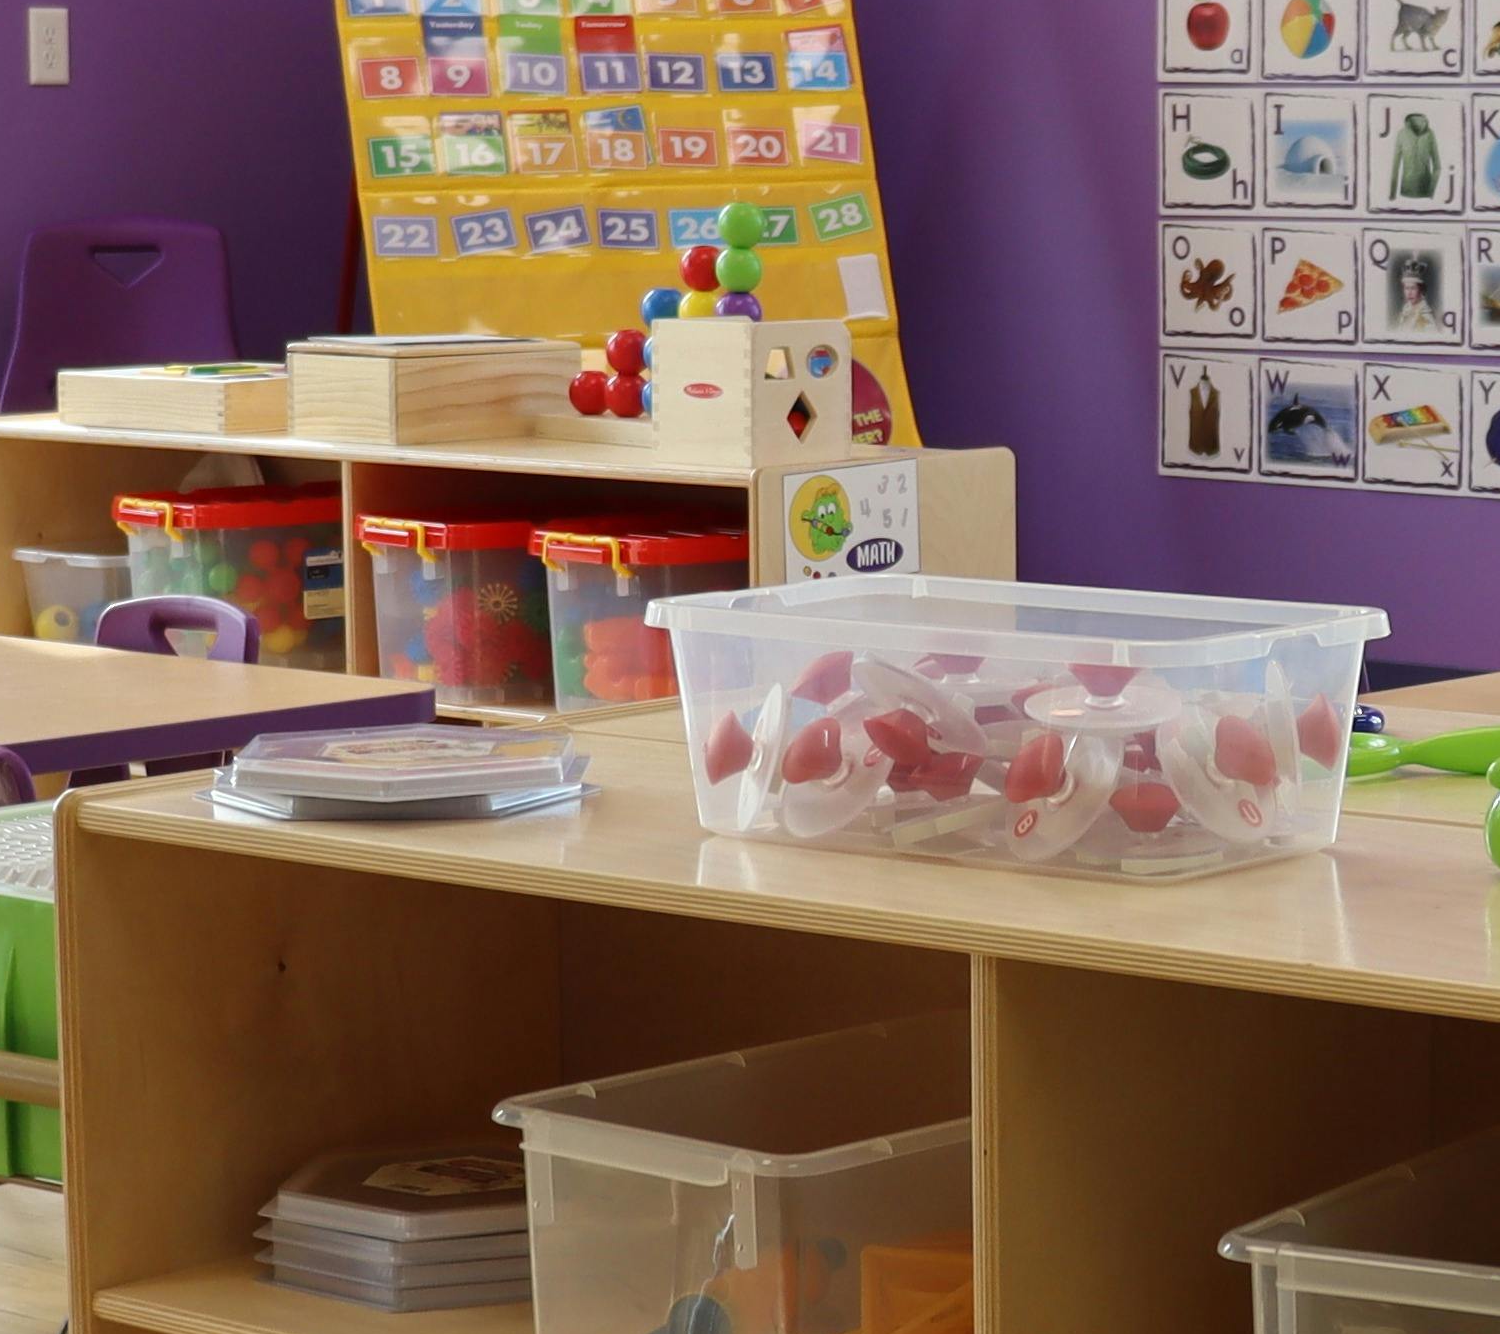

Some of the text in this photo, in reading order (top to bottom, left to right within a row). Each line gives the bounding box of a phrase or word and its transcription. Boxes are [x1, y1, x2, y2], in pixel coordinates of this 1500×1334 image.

[380, 60, 837, 90] 8 9 10 11 12 13 14
[1231, 48, 1243, 65] a
[1340, 46, 1353, 72] b
[1443, 49, 1457, 67] c
[1172, 104, 1190, 131] H
[1272, 105, 1283, 134] I
[1379, 107, 1390, 138] J
[1480, 109, 1500, 141] K
[381, 129, 847, 168] 15 16 17 18 19 20 21
[1232, 169, 1248, 200] h
[1444, 165, 1454, 204] j
[381, 225, 430, 249] 22
[461, 218, 508, 244] 23
[534, 217, 583, 244] 24
[605, 217, 651, 241] 25
[677, 216, 720, 240] 26
[818, 201, 864, 231] 28
[1172, 236, 1190, 260] O
[1271, 237, 1286, 264] P
[1369, 239, 1390, 269] Q
[1477, 237, 1493, 263] R
[1229, 307, 1245, 327] o
[1338, 311, 1352, 334] p
[1442, 310, 1456, 337] q
[1169, 365, 1186, 388] V
[1267, 369, 1291, 394] W
[1373, 375, 1391, 400] X
[1479, 380, 1496, 404] Y
[1234, 448, 1244, 462] v
[877, 473, 907, 495] 3 2
[860, 497, 871, 517] 4
[882, 508, 893, 529] 5
[856, 540, 896, 569] MATH
